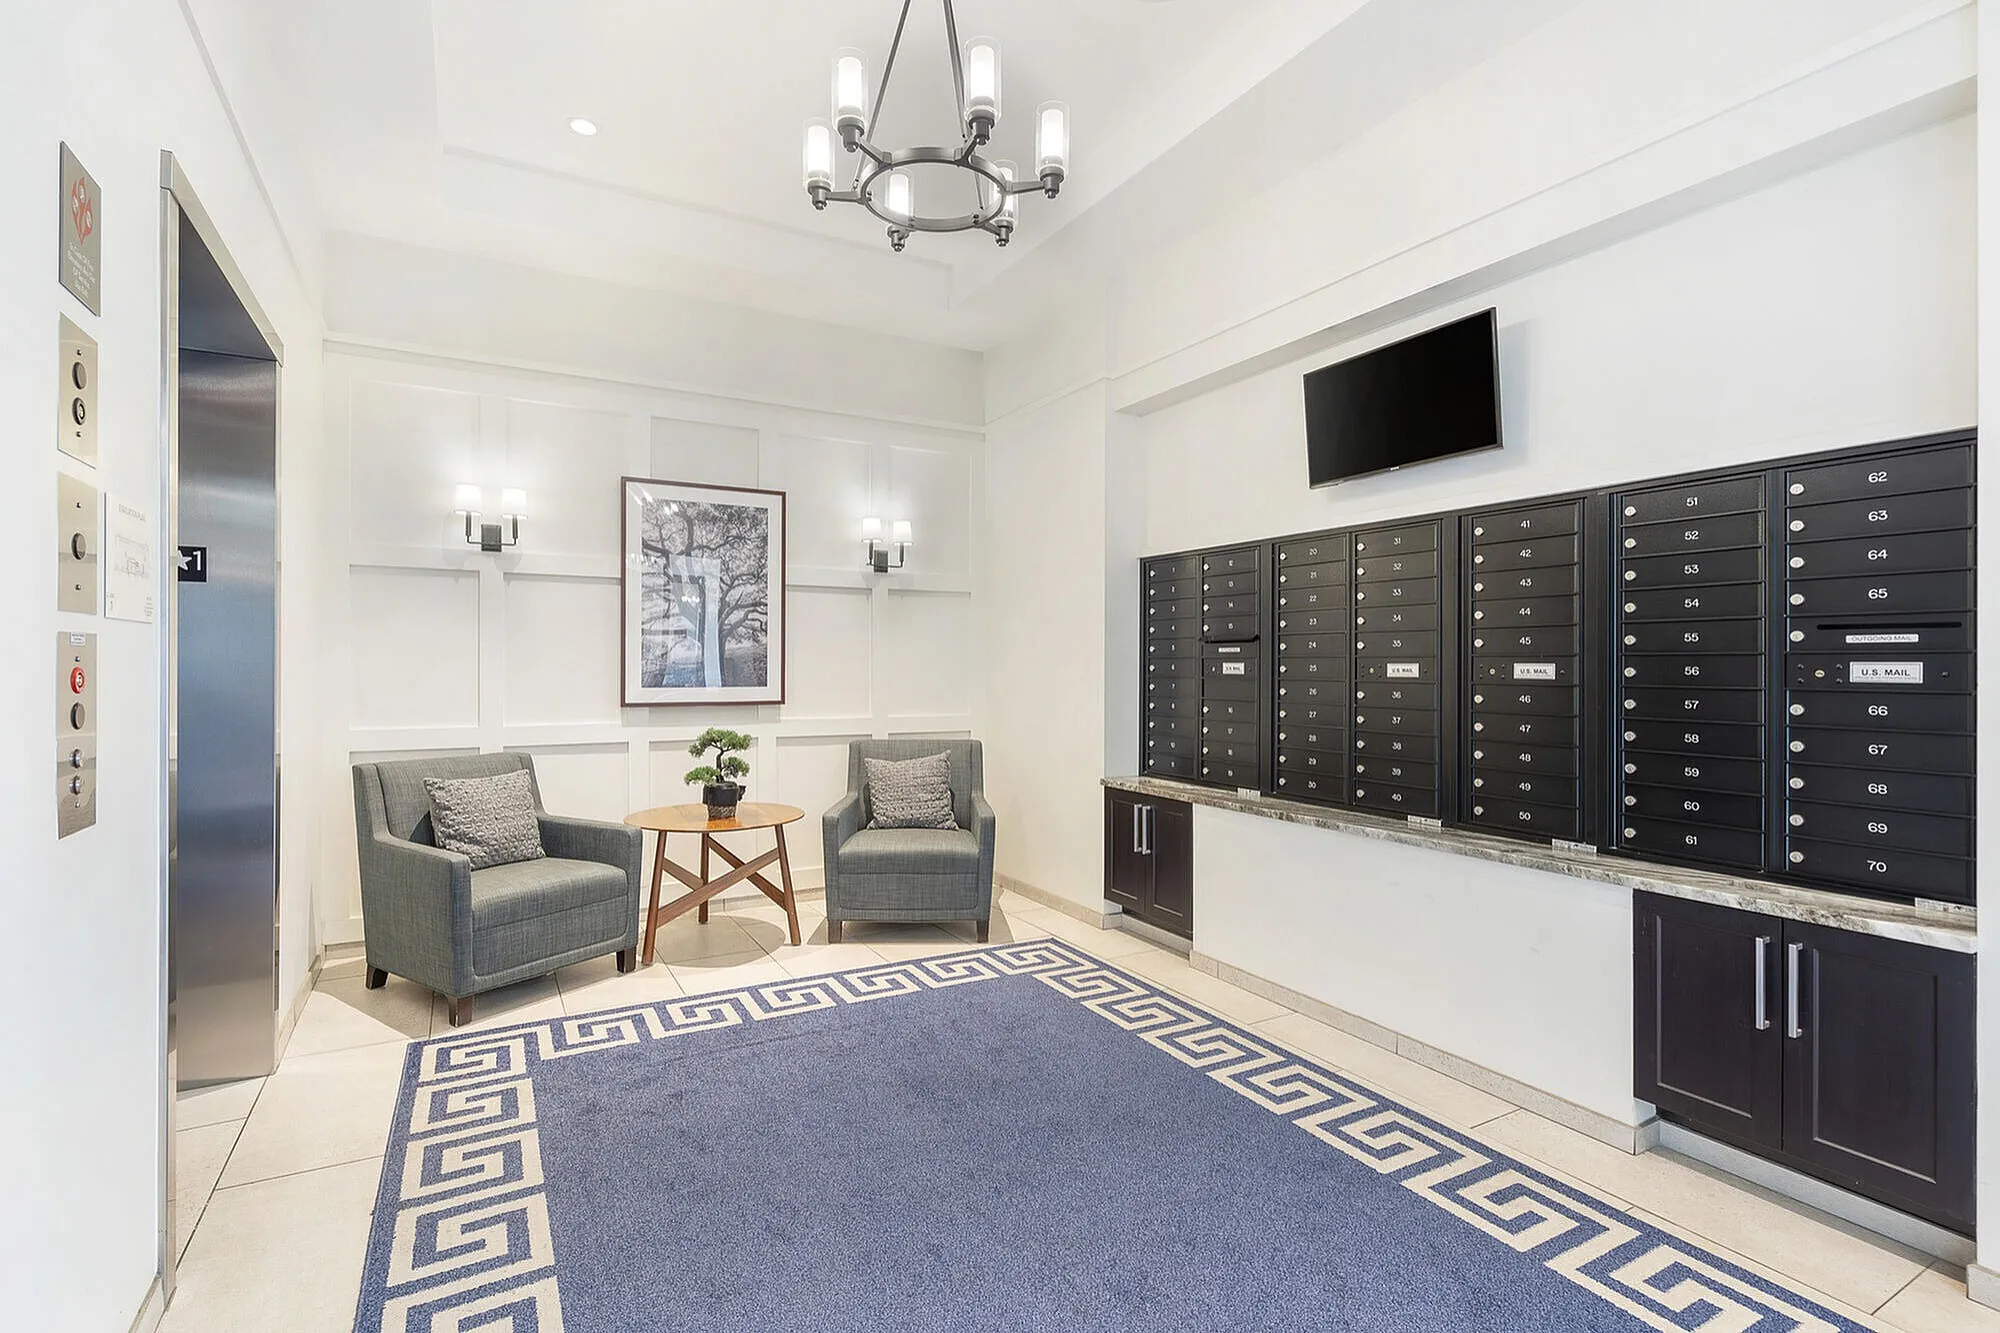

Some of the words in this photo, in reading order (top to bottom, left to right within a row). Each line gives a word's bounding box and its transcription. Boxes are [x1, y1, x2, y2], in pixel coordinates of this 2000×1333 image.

[1868, 471, 1888, 483] 62
[1686, 496, 1698, 507] 51
[1868, 509, 1888, 522] 63
[1520, 519, 1530, 528] 41
[1684, 530, 1699, 541] 52
[1393, 537, 1401, 545] 31
[1519, 548, 1532, 558] 42
[1867, 548, 1888, 561] 64
[193, 551, 201, 570] 1
[1392, 562, 1402, 571] 32
[1684, 564, 1700, 575] 53
[1519, 578, 1532, 587] 43
[1392, 588, 1402, 597] 33
[1868, 587, 1888, 600] 65
[1309, 594, 1317, 603] 22
[1684, 598, 1700, 608] 54
[1519, 607, 1531, 616] 44
[1309, 617, 1317, 626] 23
[1392, 614, 1402, 622] 34
[1519, 636, 1532, 645] 45
[1684, 632, 1699, 643] 55
[1308, 641, 1317, 649] 24
[1392, 639, 1402, 648] 35
[1309, 664, 1318, 672] 25
[1684, 666, 1700, 676] 56
[1309, 688, 1317, 696] 26
[1391, 691, 1402, 699] 36
[1518, 695, 1531, 704] 46
[1684, 699, 1700, 710] 57
[1308, 710, 1317, 719] 27
[1867, 705, 1889, 717] 66
[1391, 716, 1401, 724] 37
[1519, 724, 1531, 733] 47
[1684, 733, 1700, 744] 58
[1392, 741, 1402, 751] 38
[1868, 744, 1888, 756] 67
[1308, 757, 1317, 765] 29
[1519, 753, 1532, 762] 48
[1391, 767, 1402, 776] 39
[1684, 767, 1700, 778] 59
[1307, 780, 1317, 789] 30
[1518, 782, 1531, 792] 49
[1867, 783, 1888, 795] 68
[1391, 793, 1402, 802] 40
[1683, 800, 1700, 812] 60
[1518, 811, 1531, 821] 50
[1867, 822, 1888, 834] 69
[1685, 835, 1698, 845] 61
[1866, 859, 1887, 873] 70
